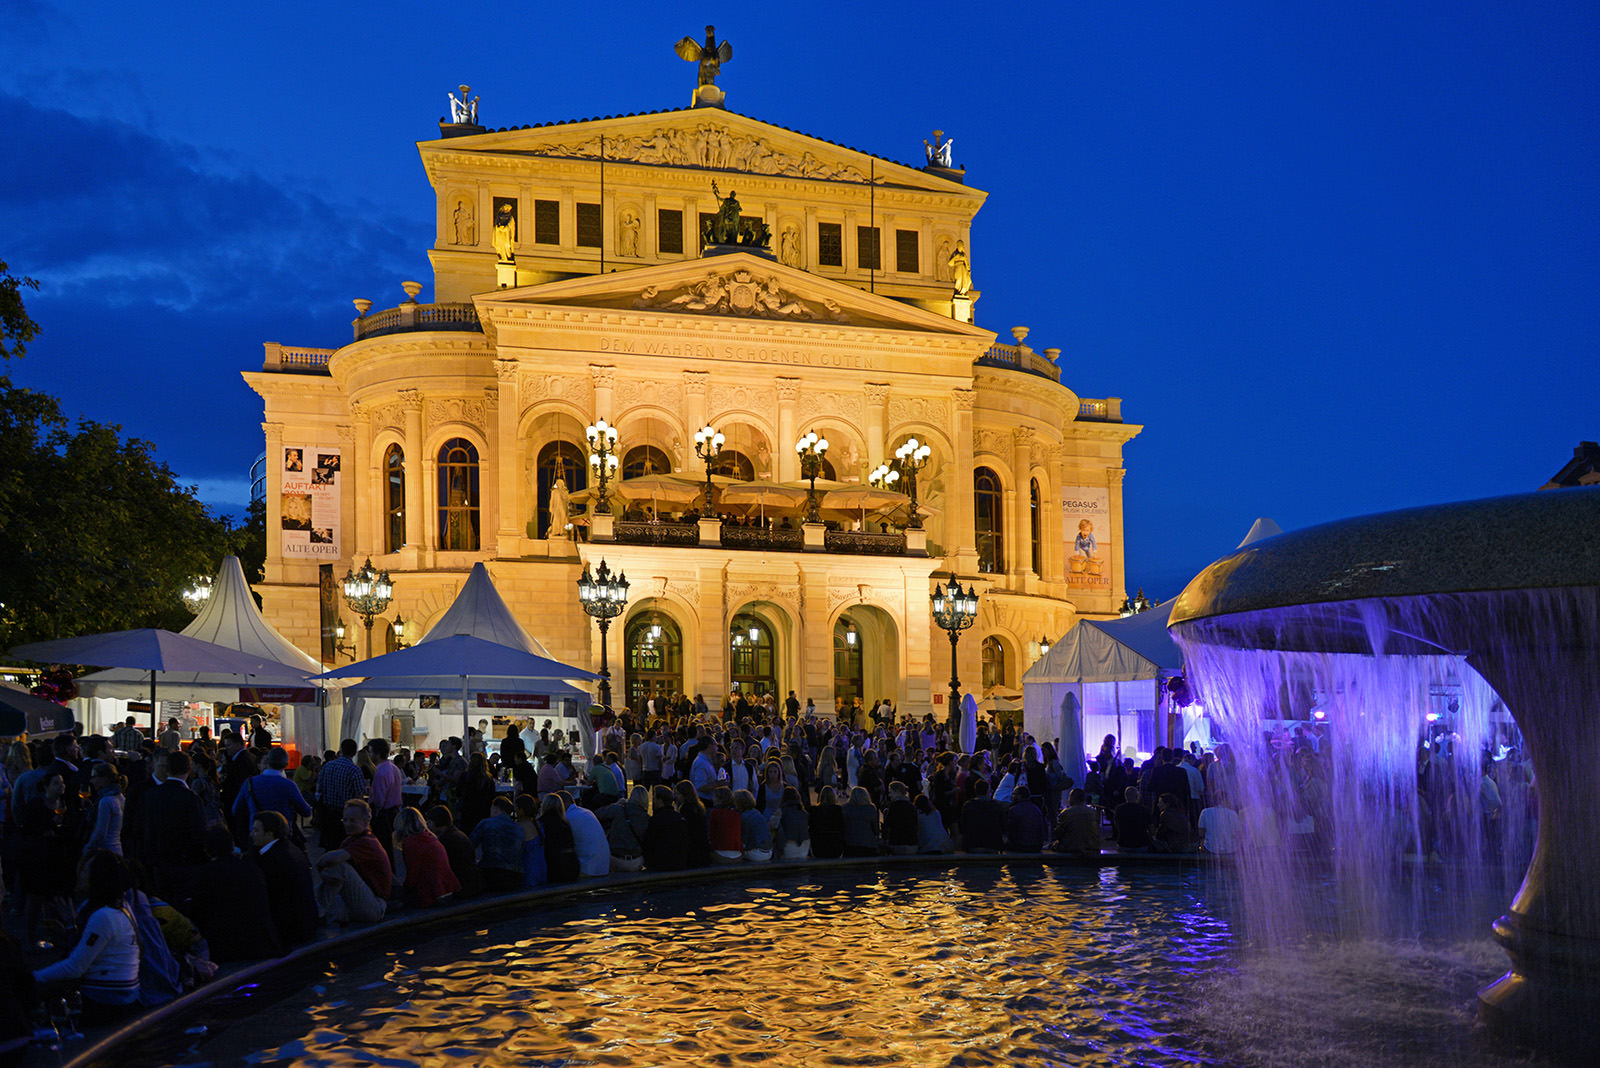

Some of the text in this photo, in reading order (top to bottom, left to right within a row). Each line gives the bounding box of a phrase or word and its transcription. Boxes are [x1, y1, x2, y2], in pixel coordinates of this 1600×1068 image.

[600, 337, 873, 368] DEM WAHREN SCHOENEN GUTEN
[284, 482, 327, 491] AUFTAKT
[284, 490, 305, 498] 2012
[1062, 500, 1098, 508] PEGASUS
[285, 544, 338, 555] ALTE OPER
[1065, 576, 1110, 585] ALTE OPER
